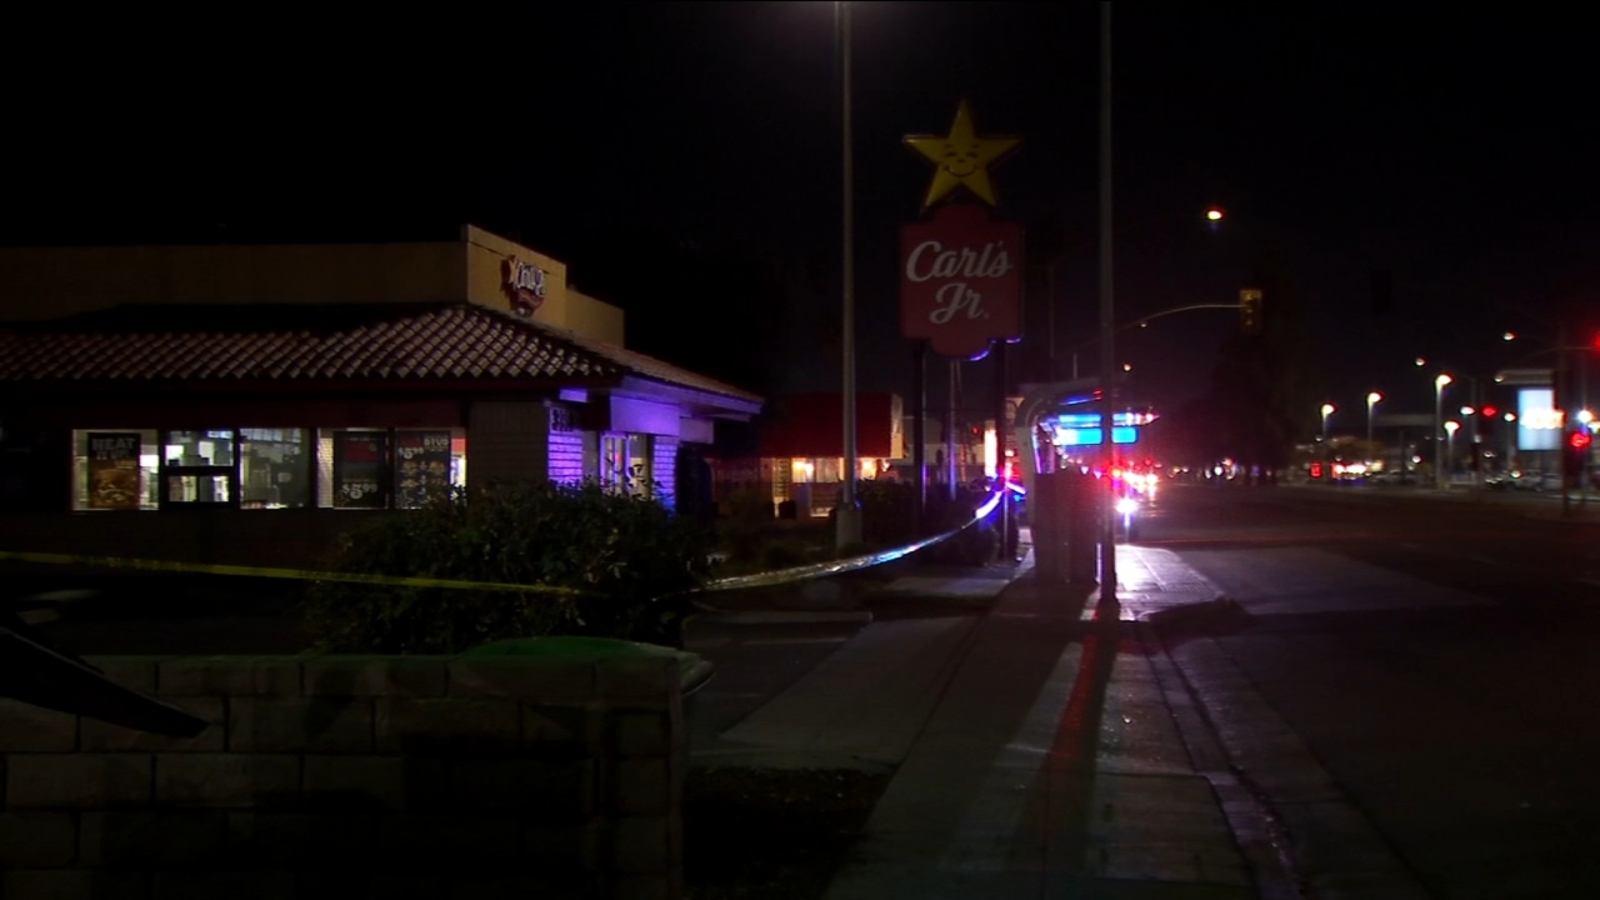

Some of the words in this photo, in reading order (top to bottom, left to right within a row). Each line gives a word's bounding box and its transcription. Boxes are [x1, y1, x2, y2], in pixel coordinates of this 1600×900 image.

[906, 240, 1014, 283] Carl's
[929, 282, 990, 325] Jr.
[91, 438, 136, 450] HEAT
